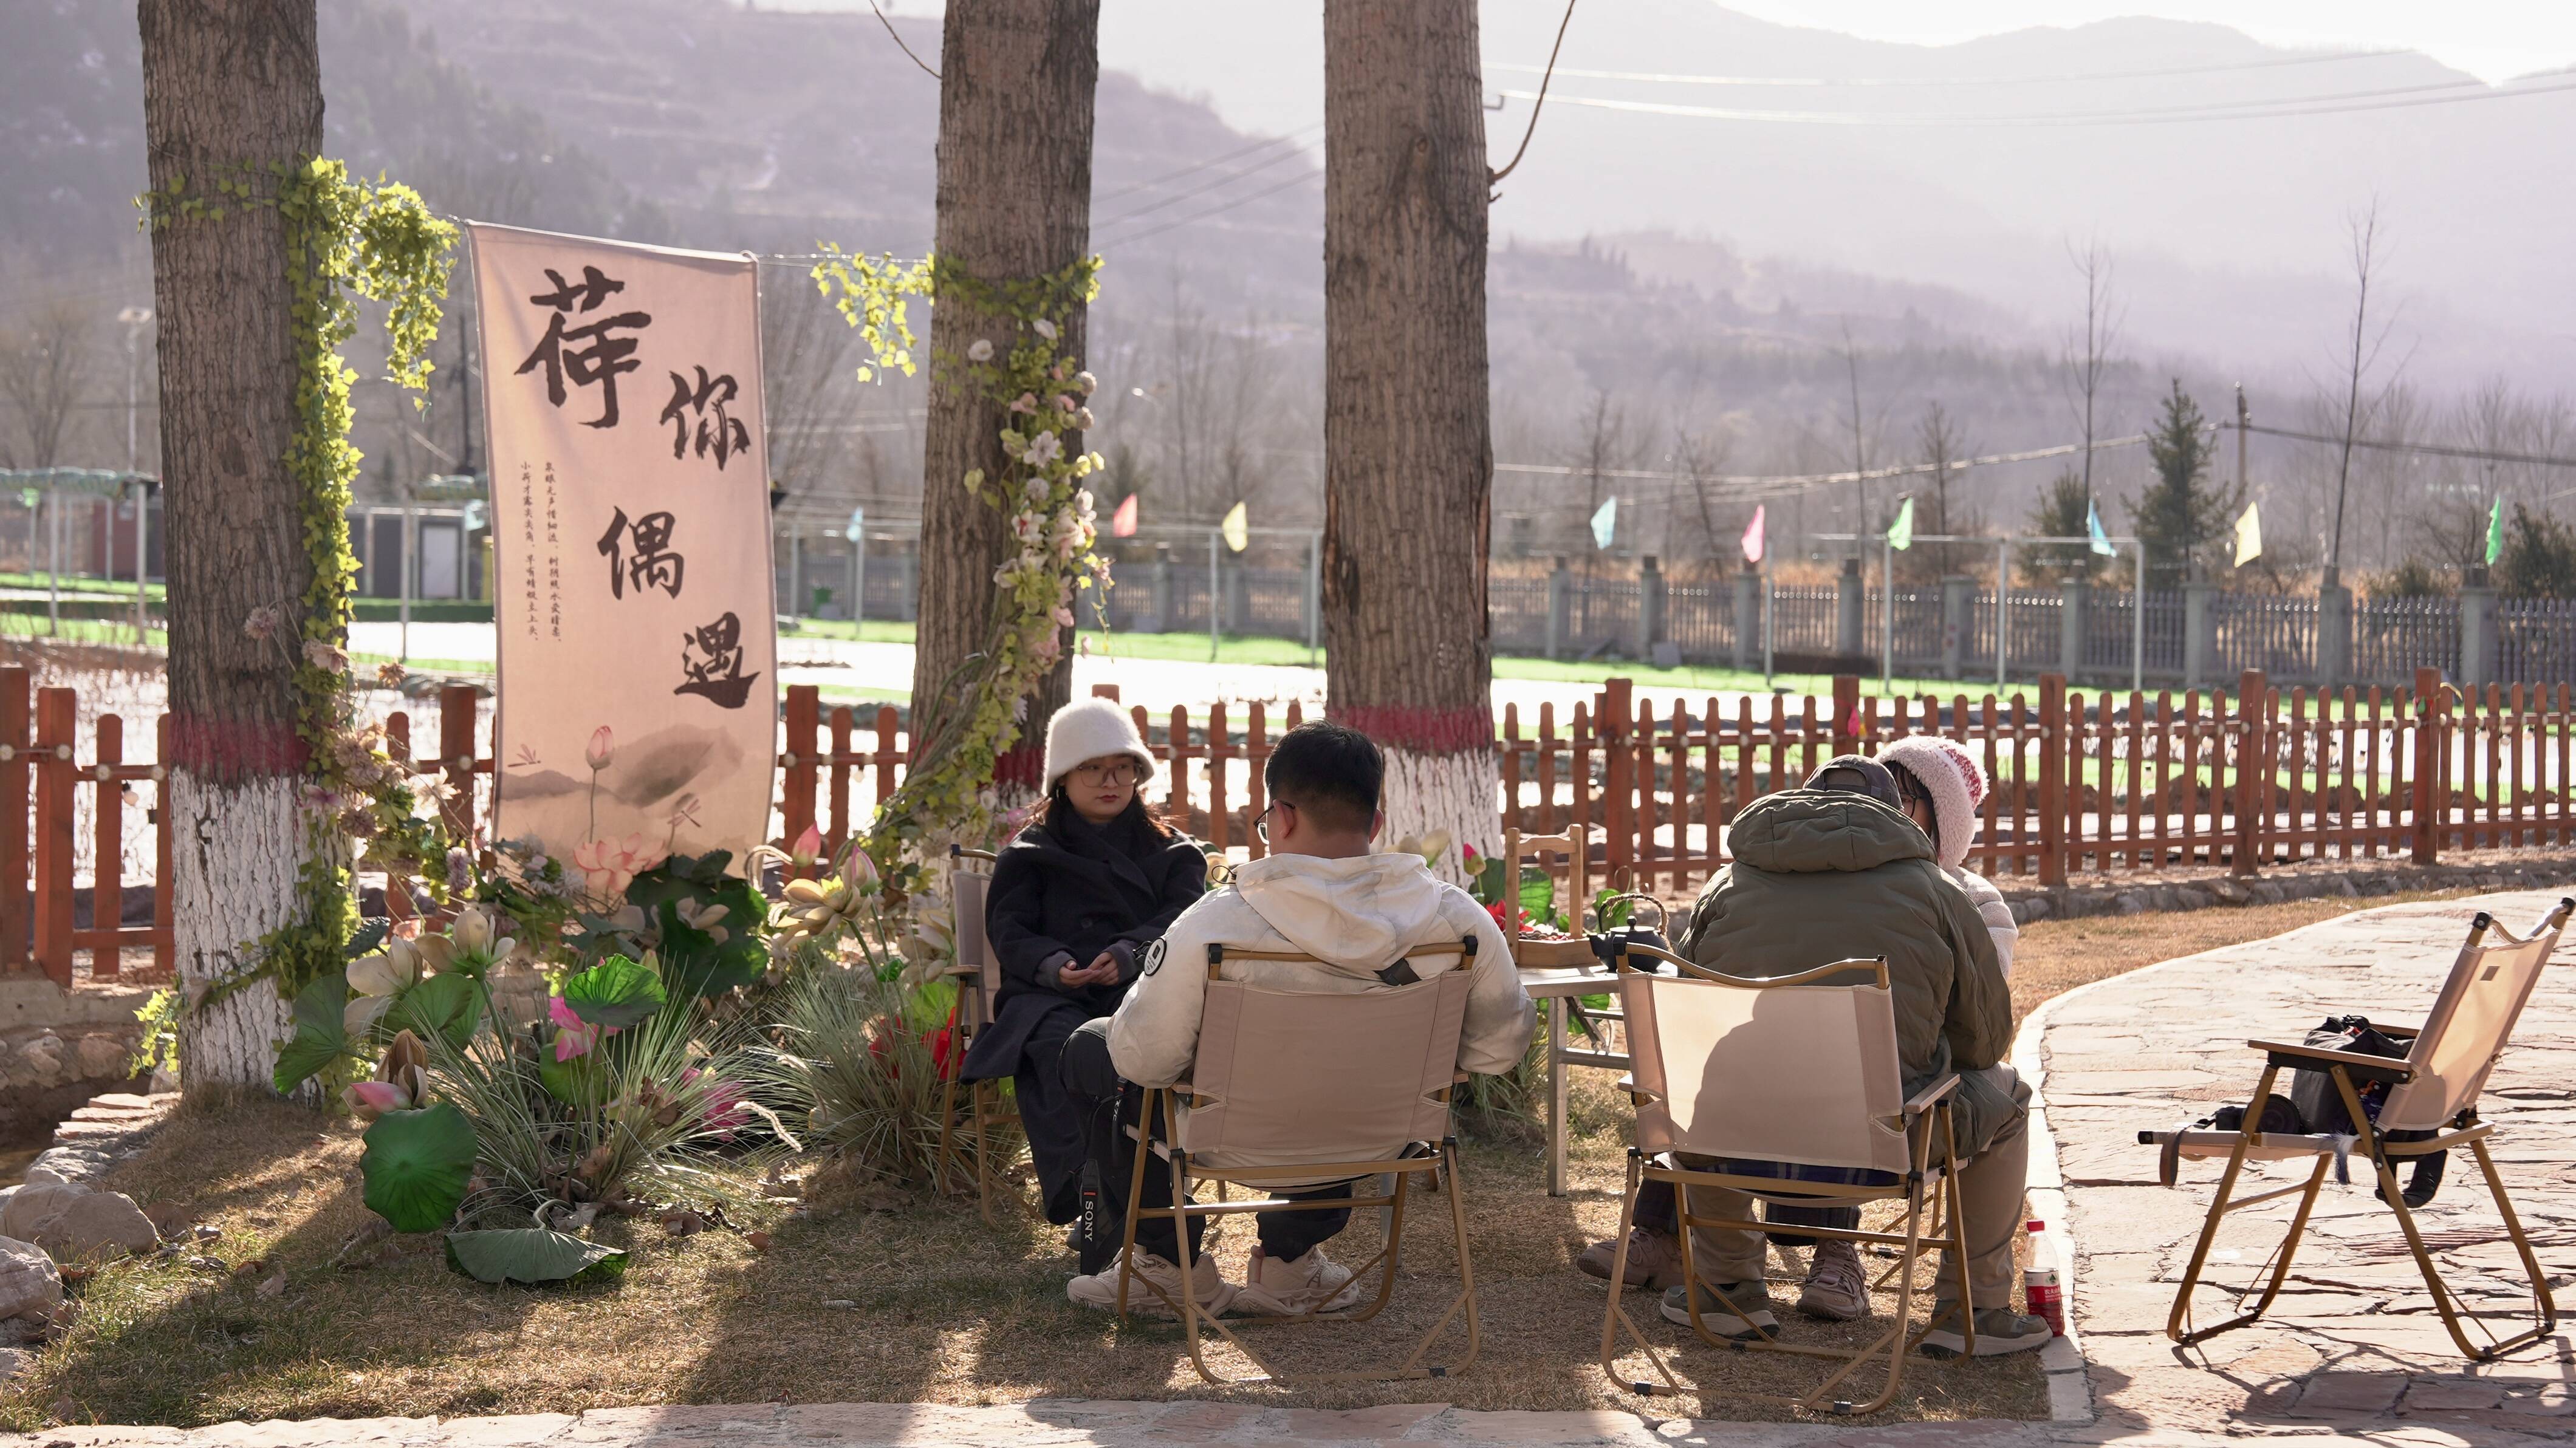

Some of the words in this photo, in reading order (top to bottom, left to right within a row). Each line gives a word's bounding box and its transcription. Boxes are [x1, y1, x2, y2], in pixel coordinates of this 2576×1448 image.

[515, 265, 651, 428] 荷
[659, 365, 750, 470] 你
[597, 506, 683, 599] 偶
[673, 612, 759, 708] 遇
[1084, 1201, 1094, 1242] SONY
